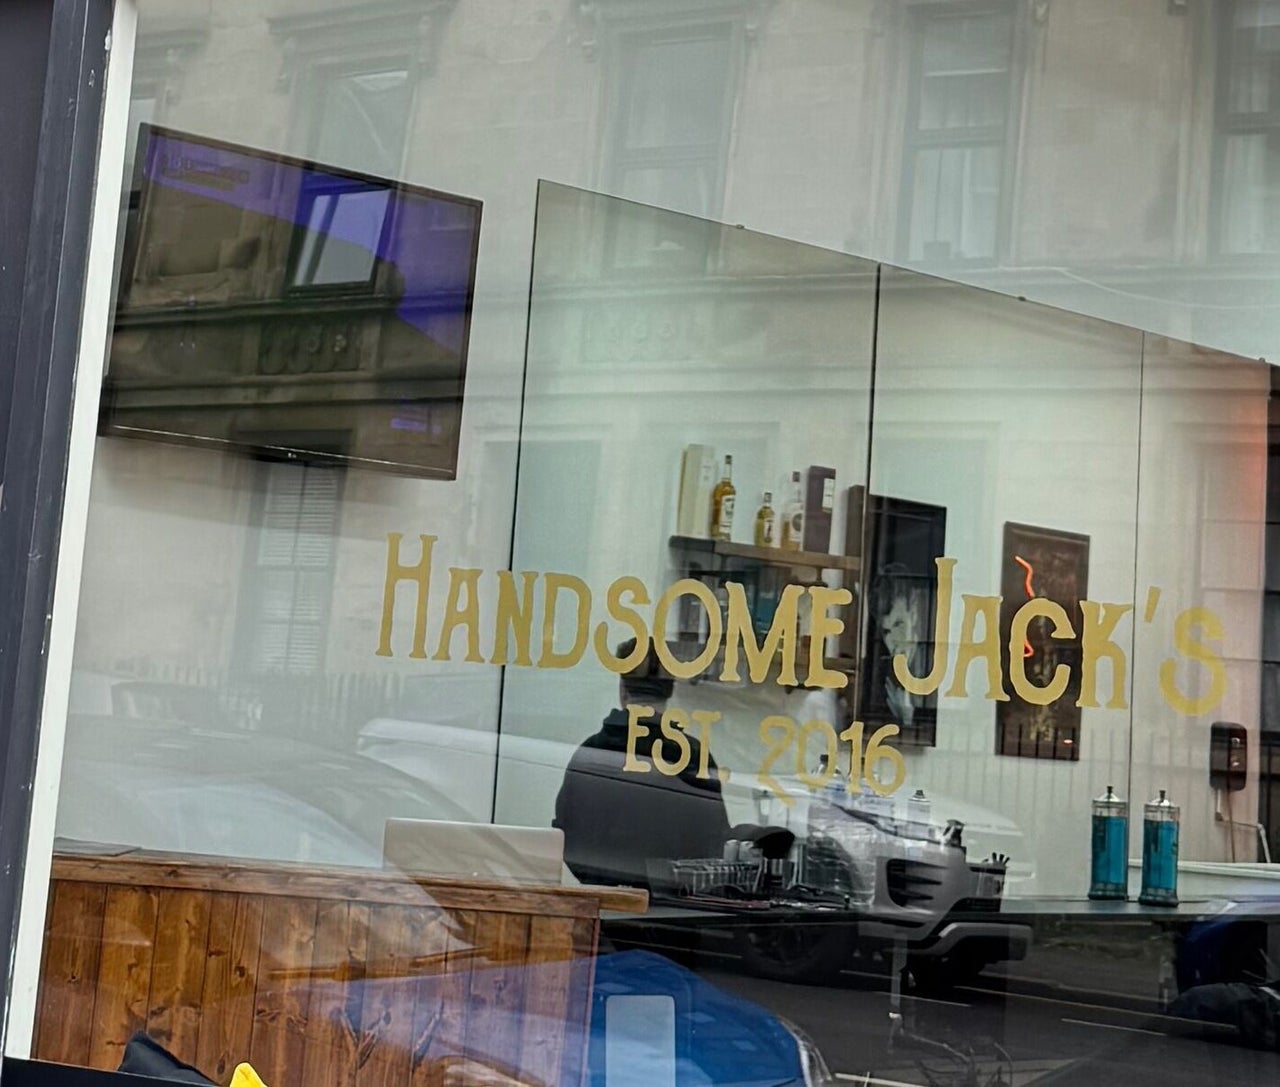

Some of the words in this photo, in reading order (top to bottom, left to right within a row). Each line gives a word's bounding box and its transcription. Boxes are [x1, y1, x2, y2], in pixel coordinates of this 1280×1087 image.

[375, 532, 853, 690] HANDSOME
[893, 557, 1227, 717] JACK'S
[623, 704, 731, 780] EST.
[757, 714, 907, 808] 2016
